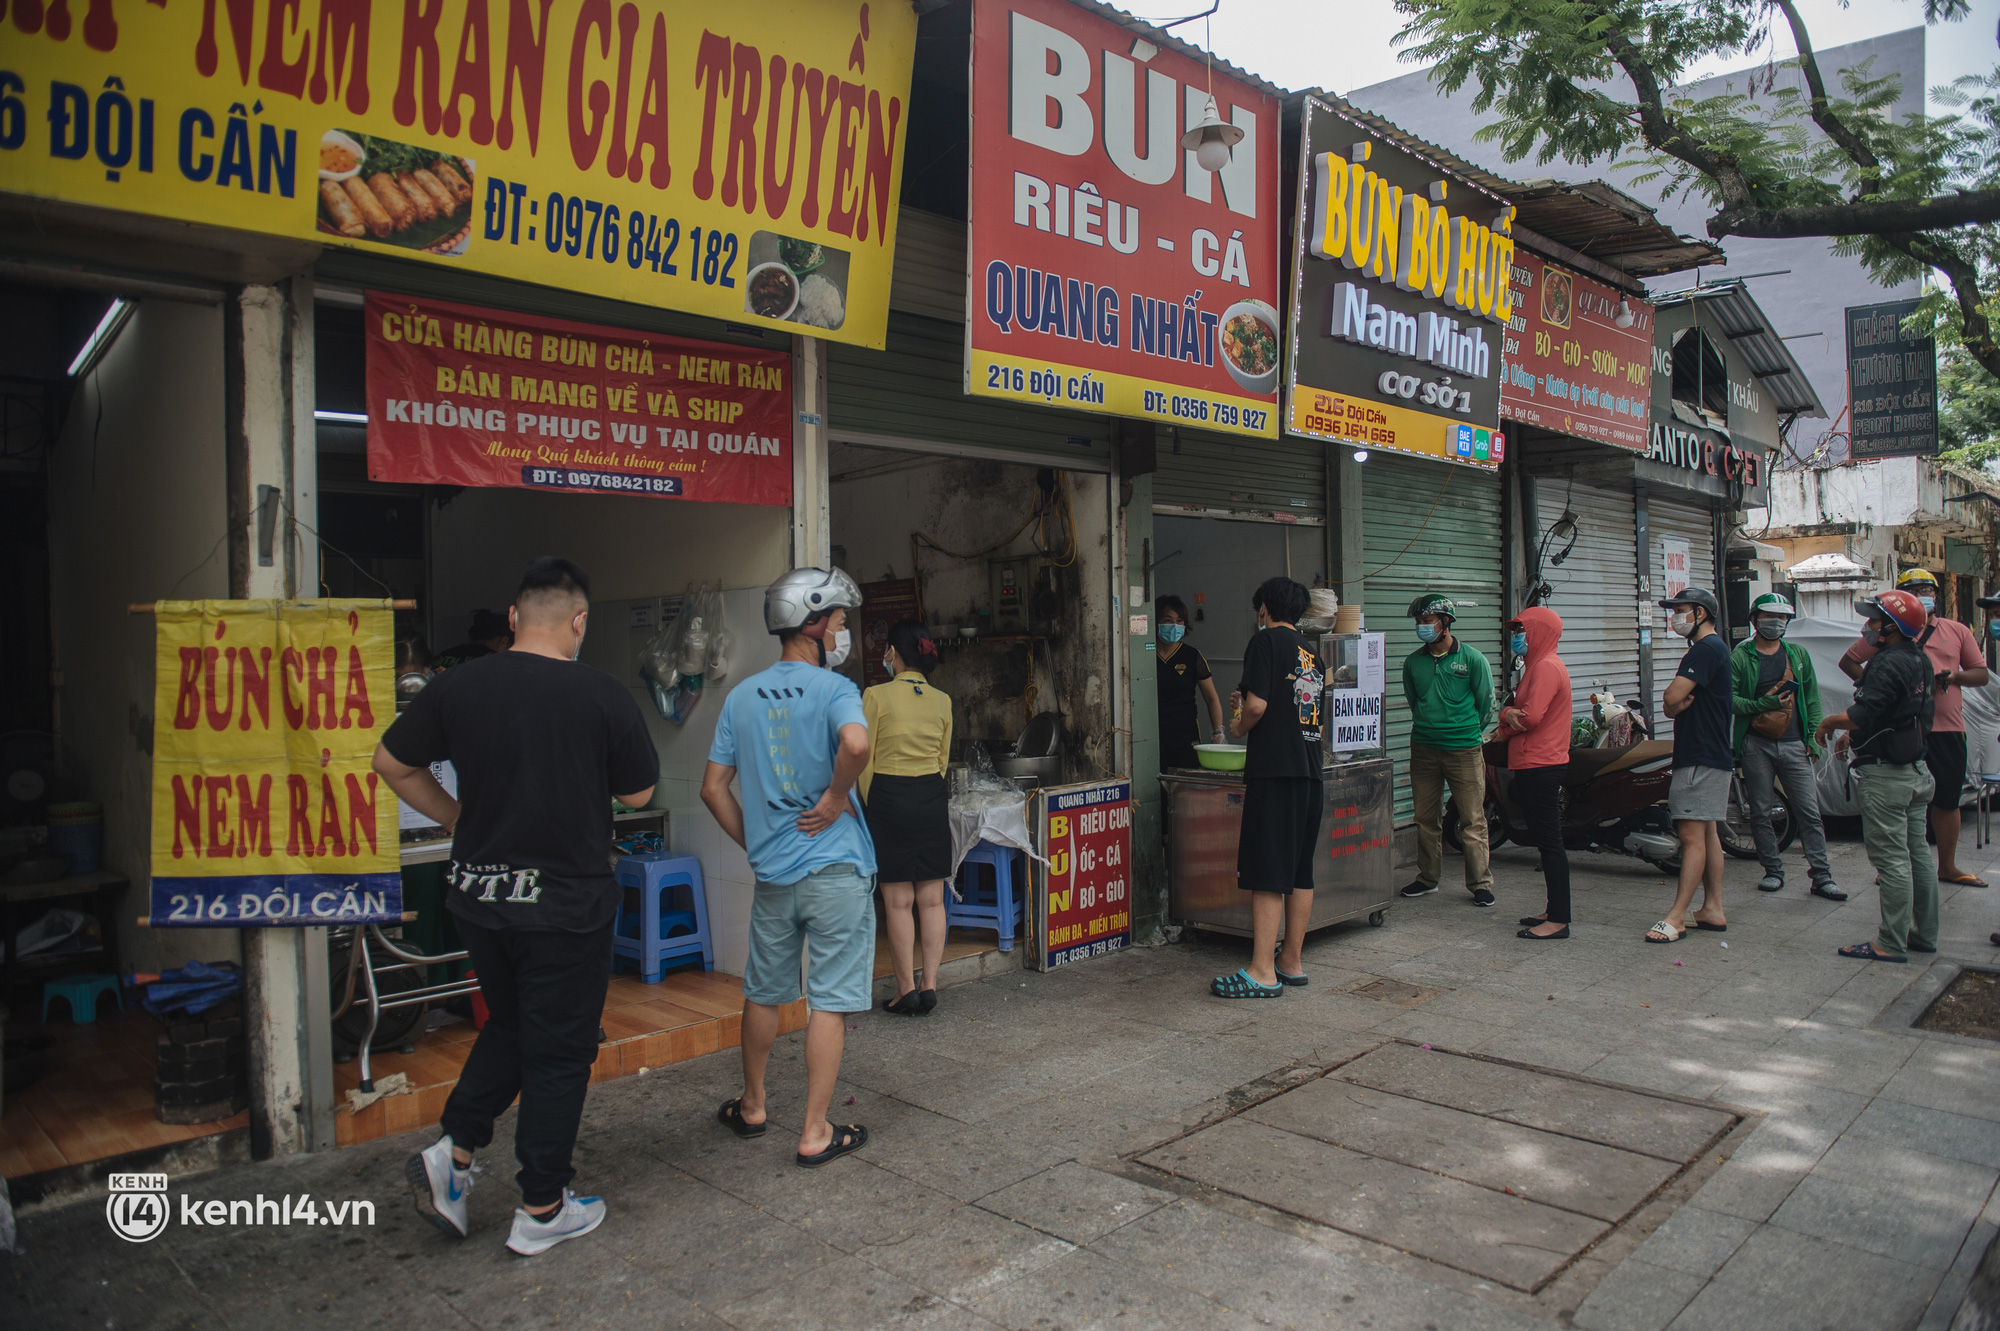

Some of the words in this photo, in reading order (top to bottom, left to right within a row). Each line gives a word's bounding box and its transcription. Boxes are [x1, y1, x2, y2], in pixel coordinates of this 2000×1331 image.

[567, 0, 672, 190] GIA
[692, 3, 901, 247] TRUYỀN
[1008, 9, 1257, 219] BÚN
[47, 75, 154, 183] ĐỘI
[178, 99, 297, 199] CẤN
[627, 210, 680, 276] 842
[690, 226, 738, 289] 182
[1013, 170, 1140, 255] RIÊU
[1190, 228, 1251, 288] CÁ
[1312, 140, 1403, 283] BÚN
[1447, 205, 1517, 324] HUẾ
[1509, 265, 1534, 288] UYÊN
[985, 260, 1120, 348] QUANG
[1130, 289, 1219, 368] NHẤT
[1331, 281, 1417, 356] Nam
[1416, 311, 1490, 379] Minh
[1506, 312, 1527, 333] ÁNH
[1853, 310, 1896, 348] KHÁCH
[382, 303, 444, 348] CỬA
[453, 320, 532, 360] HÀNG
[541, 333, 597, 368] BÚN
[604, 339, 654, 376] CHẢ
[678, 354, 730, 386] NEM
[737, 358, 783, 391] RÁN
[1505, 337, 1520, 355] ĐA
[1535, 329, 1551, 359] BÒ
[1562, 339, 1581, 367] GIÒ
[1626, 361, 1647, 389] MỌC
[1652, 345, 1673, 377] NG
[1852, 352, 1903, 387] THƯƠNG
[1905, 350, 1931, 386] MẠI
[436, 364, 500, 398] BÁN
[510, 376, 598, 409] MANG
[605, 381, 639, 414] VỀ
[647, 387, 680, 418] VÀ
[687, 397, 744, 424] SHIP
[986, 364, 1024, 392] 216
[1029, 369, 1062, 401] ĐỘI
[1067, 372, 1105, 405] CẤN
[1143, 389, 1168, 414] ĐT:
[1171, 397, 1208, 421] 0356
[1212, 402, 1239, 426] 759
[1242, 407, 1267, 432] 927
[1314, 393, 1345, 417] 216
[1733, 377, 1759, 414] KHẨU
[386, 398, 506, 432] KHÔNG
[516, 412, 600, 445] PHỤC
[609, 421, 648, 450] VỤ
[655, 426, 699, 453] TẠI
[706, 427, 780, 457] QUÁN
[1305, 414, 1341, 434] 0936
[1344, 421, 1367, 439] 164
[1371, 427, 1395, 444] 669
[1854, 415, 1892, 436] PEONY
[1893, 412, 1933, 432] HOUSE
[482, 440, 532, 463] Mong
[536, 444, 568, 465] Quý
[573, 447, 620, 468] khách
[623, 455, 665, 472] thông
[1474, 439, 1488, 451] Grab
[1645, 421, 1700, 471] ANTO
[532, 469, 563, 484] ĐT:
[567, 472, 675, 493] 0976842182
[173, 619, 272, 731] BÚN
[281, 610, 375, 731] CHẢ
[768, 707, 790, 720] NYC
[1335, 694, 1353, 717] BÁN
[1356, 694, 1379, 716] HÀNG
[1338, 725, 1364, 743] MANG
[1367, 719, 1377, 741] VỀ
[171, 773, 272, 859] NEM
[1058, 792, 1084, 809] QUANG
[1106, 787, 1120, 801] 216
[1080, 806, 1106, 836] RIÊU
[1109, 806, 1130, 831] CUA
[1079, 842, 1095, 873] ỐC
[1106, 839, 1121, 868] CÁ
[169, 893, 228, 921] 216
[237, 886, 299, 924] ĐỘI
[311, 882, 386, 918] CẤN
[1079, 880, 1095, 910] BÒ
[1106, 874, 1125, 903] GIÒ
[1049, 924, 1070, 947] BÁNH
[1071, 922, 1082, 942] ĐA
[1109, 910, 1128, 933] TRỘN
[1069, 944, 1089, 962] 0356
[1091, 940, 1106, 957] 759
[1107, 936, 1122, 952] 927
